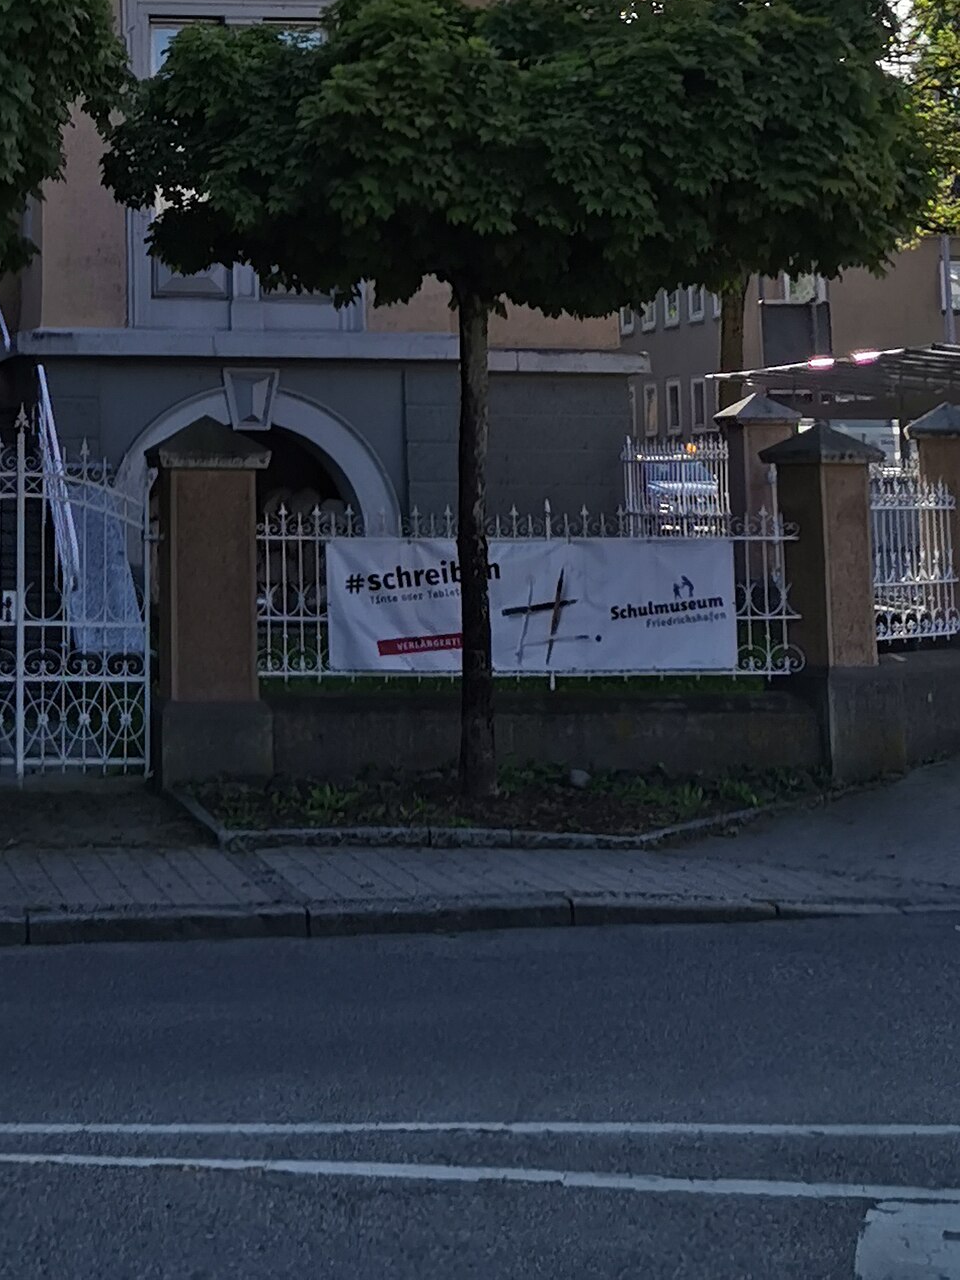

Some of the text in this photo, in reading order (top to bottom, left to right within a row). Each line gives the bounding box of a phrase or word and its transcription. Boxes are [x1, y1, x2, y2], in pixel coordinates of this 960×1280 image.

[345, 560, 501, 595] #schreibn
[370, 594, 399, 605] Tinte
[427, 587, 460, 600] Tablet
[610, 596, 724, 621] Schulmuseum
[646, 611, 727, 629] Friedrichshafen
